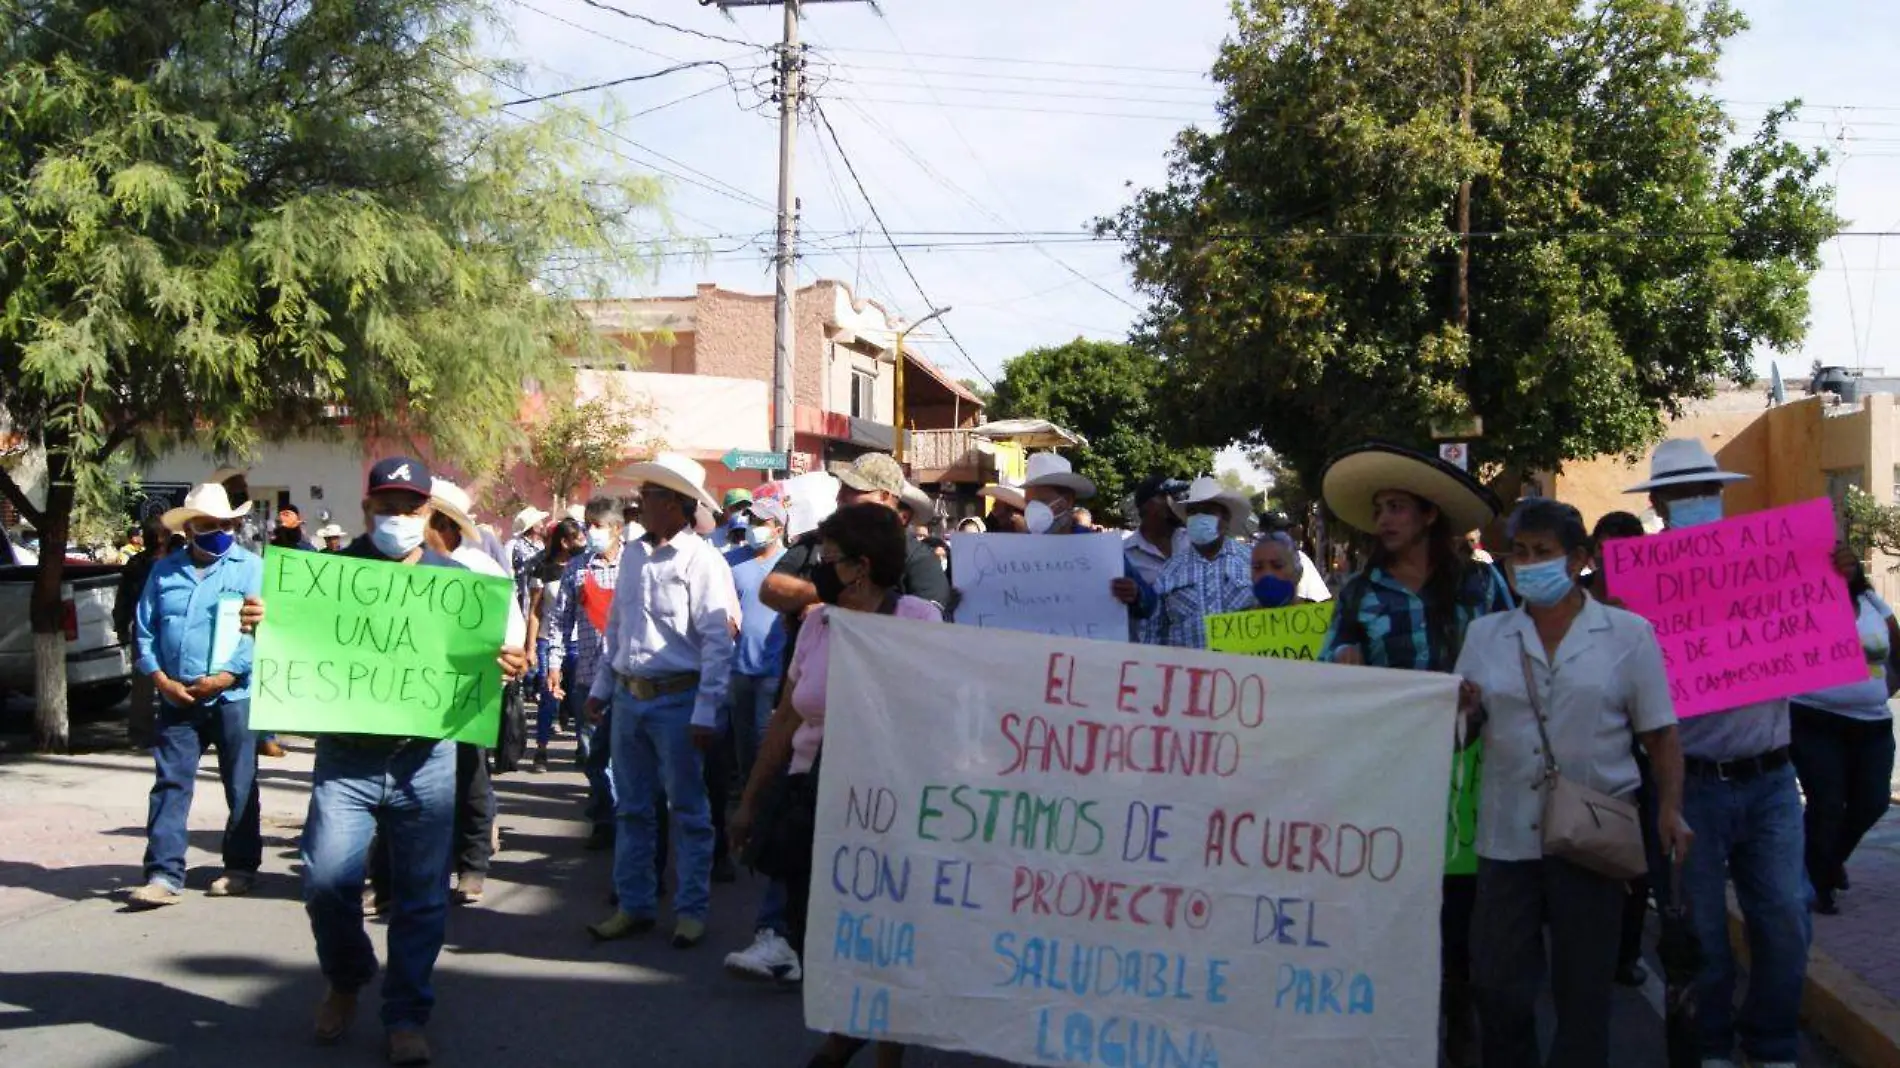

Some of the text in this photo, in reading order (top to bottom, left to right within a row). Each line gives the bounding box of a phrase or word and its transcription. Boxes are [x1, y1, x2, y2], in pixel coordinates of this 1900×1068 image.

[1613, 518, 1793, 575] EXIGIMOS A LA
[278, 554, 486, 629] EXIGIMOS
[1650, 577, 1836, 636] RIBEL AGUILERA
[1656, 551, 1800, 605] DIPUTADA
[335, 614, 418, 654] UNA
[1210, 606, 1328, 640] EXIGIMOS
[1684, 637, 1712, 662] DE
[1727, 626, 1753, 648] LA
[1762, 609, 1820, 643] CARA
[259, 658, 484, 713] RESPUESTA
[1045, 652, 1264, 728] EL EJIDO
[1670, 678, 1689, 701] OS
[847, 785, 1403, 882] NO ESTAMOS DE ACUERDO
[832, 845, 1330, 948] CON EL PROYECTO DEL
[834, 909, 1375, 1015] AGUA SALUDABLE PARA
[848, 985, 1219, 1068] LA LAGUNA
